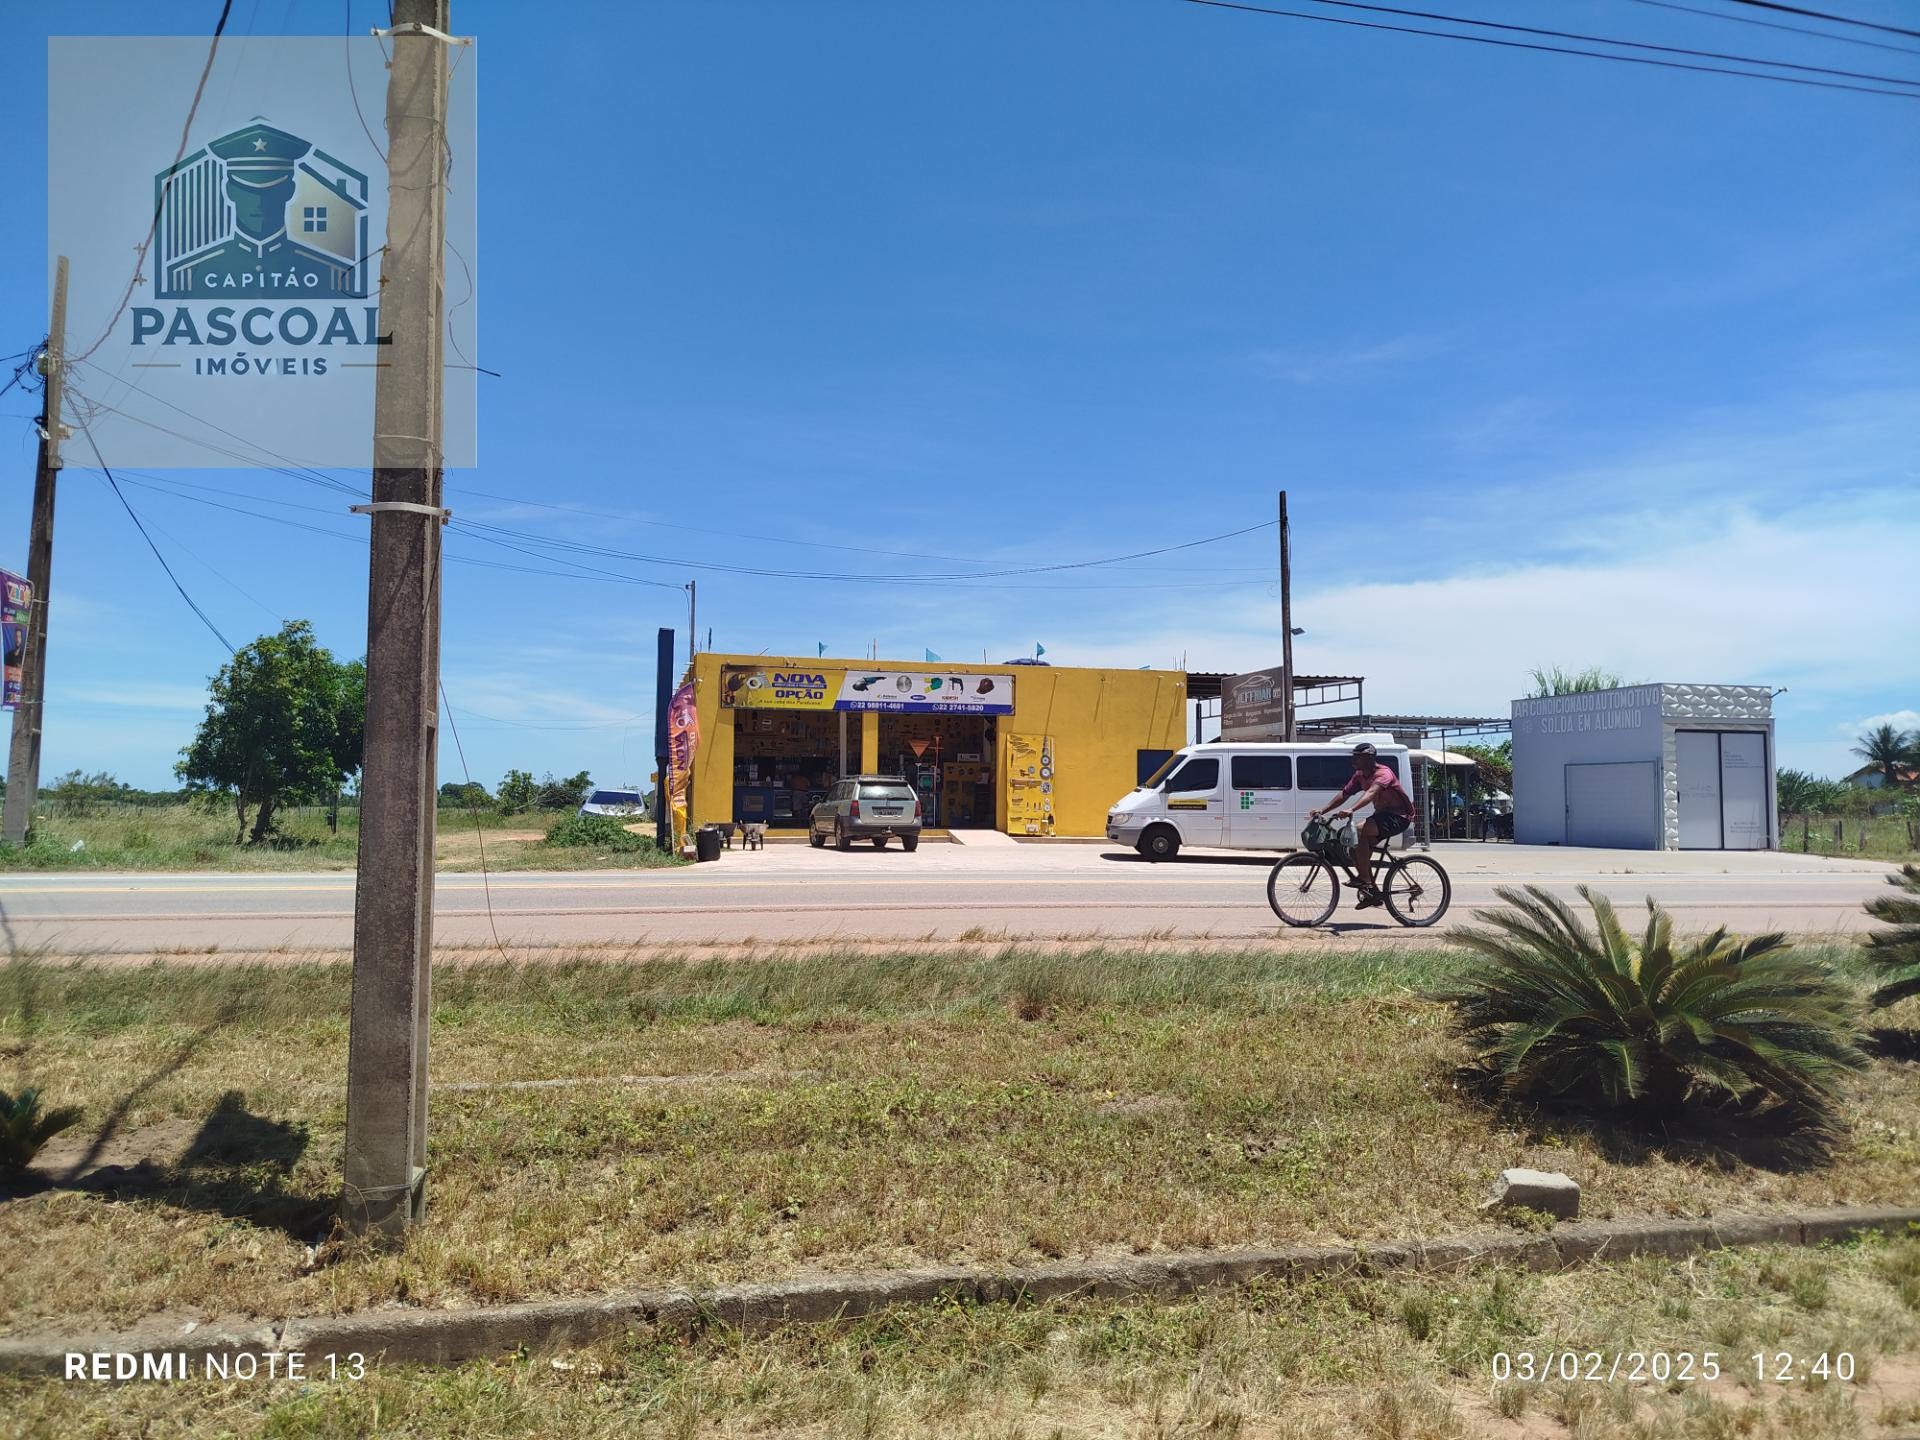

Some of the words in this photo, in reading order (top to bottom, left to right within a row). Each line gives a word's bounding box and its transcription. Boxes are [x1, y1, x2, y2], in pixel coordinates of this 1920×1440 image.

[773, 672, 827, 684] NOVA
[775, 688, 824, 701] OPÇÃO
[939, 703, 948, 711] 22
[1514, 701, 1529, 718] AR
[1530, 693, 1595, 717] CONDICIONADO
[1596, 686, 1660, 711] AUTOMOTIVO
[1541, 715, 1574, 734] SOLDA
[1579, 713, 1591, 733] EM
